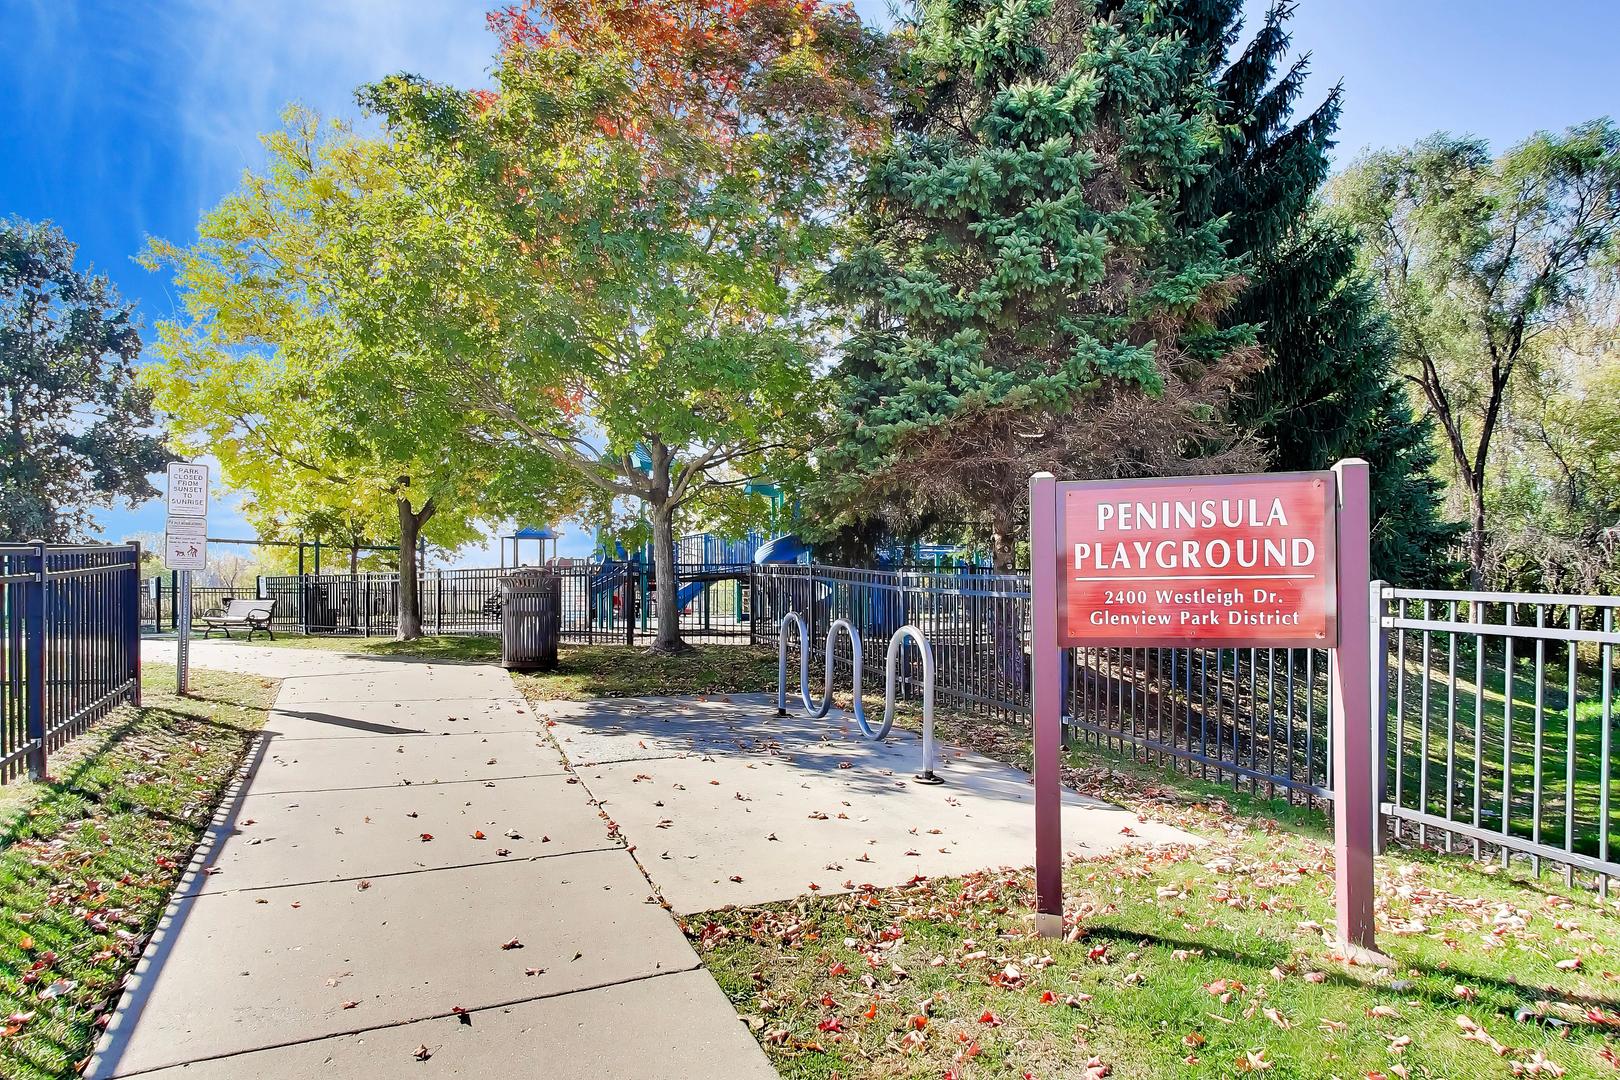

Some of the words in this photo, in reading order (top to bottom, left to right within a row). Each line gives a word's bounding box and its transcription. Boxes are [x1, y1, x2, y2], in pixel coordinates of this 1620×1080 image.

[178, 467, 199, 475] PARK
[1096, 497, 1288, 531] PENINSULA
[1073, 538, 1316, 570] PLAYGROUND
[1104, 590, 1147, 605] 2400
[1155, 589, 1244, 607] Westleigh
[1253, 589, 1284, 604] Dr.
[1090, 610, 1171, 626] Glenview
[1180, 610, 1220, 626] Park
[1228, 610, 1300, 625] District
